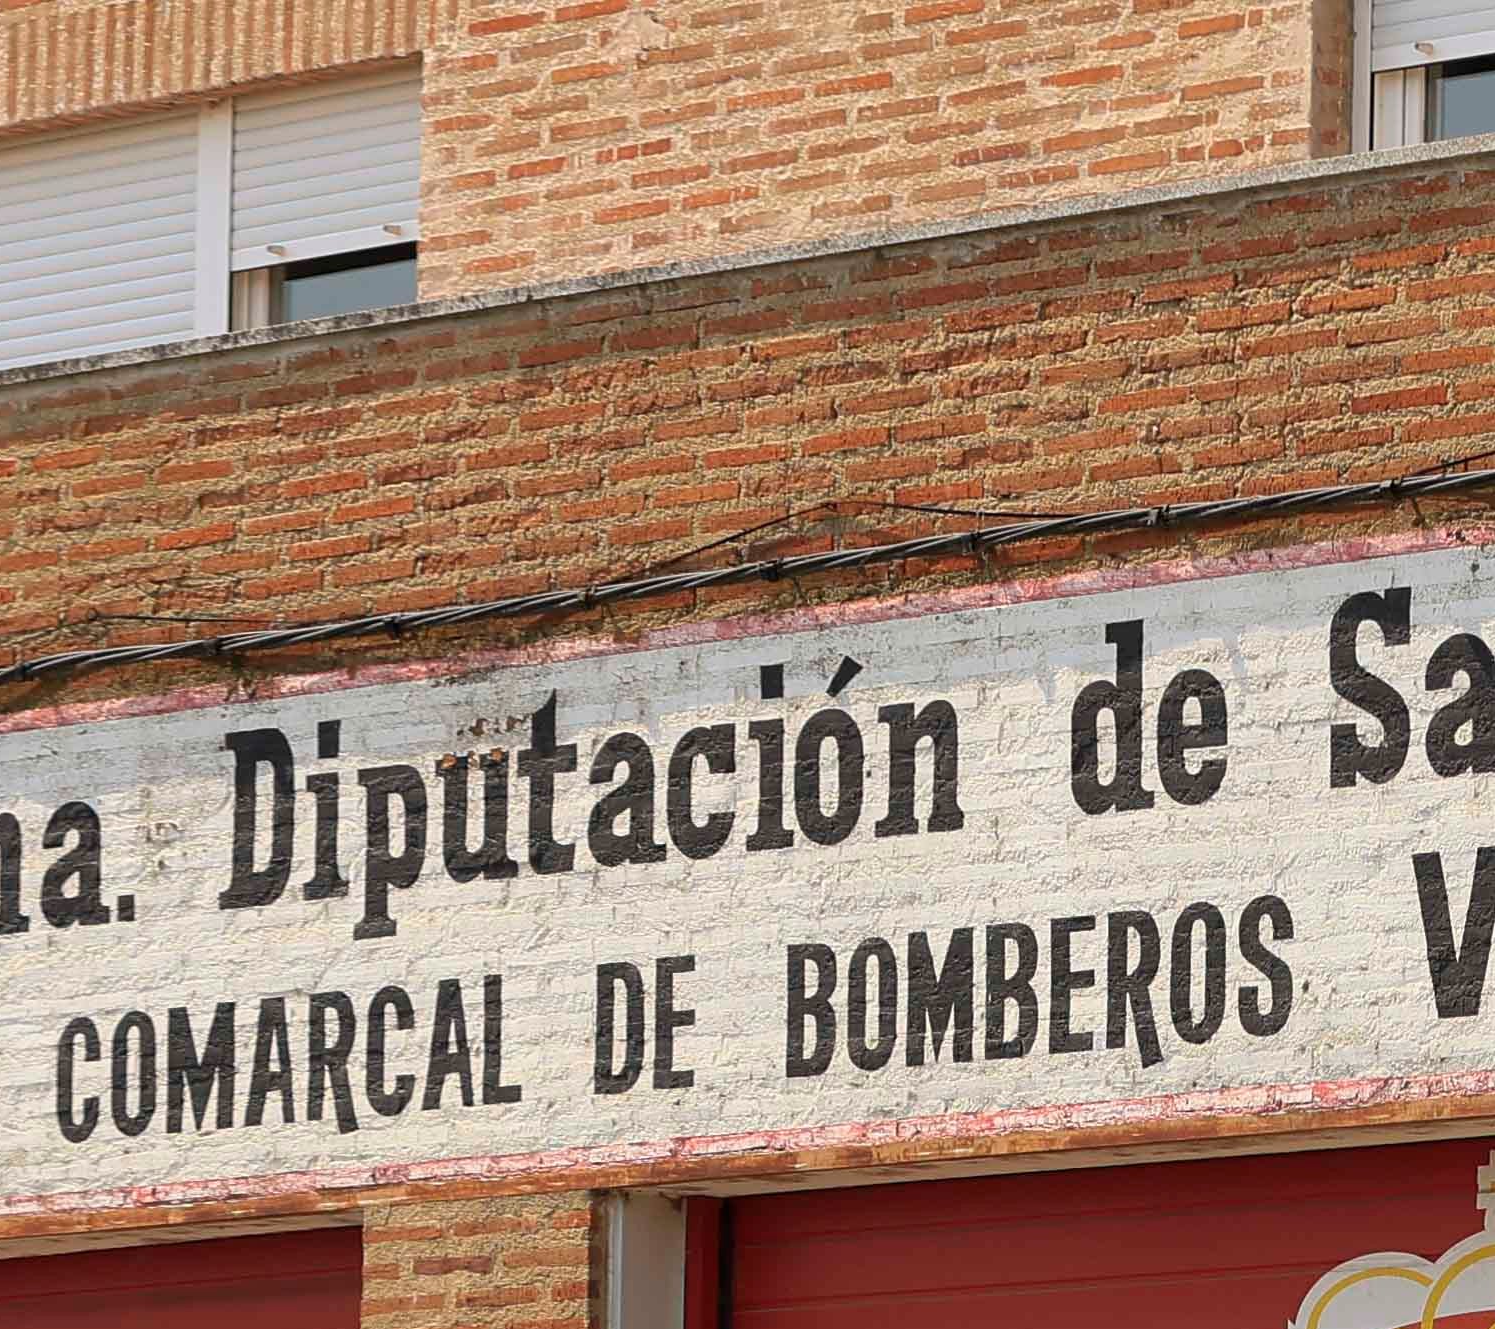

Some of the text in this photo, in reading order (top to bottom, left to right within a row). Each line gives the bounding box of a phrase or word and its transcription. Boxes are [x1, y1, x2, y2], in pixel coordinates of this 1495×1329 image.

[219, 655, 965, 941] Diputación
[1071, 618, 1229, 816] de
[56, 974, 522, 1145] COMARCAL
[593, 954, 697, 1096] DE
[786, 893, 1295, 1079] BOMBEROS
